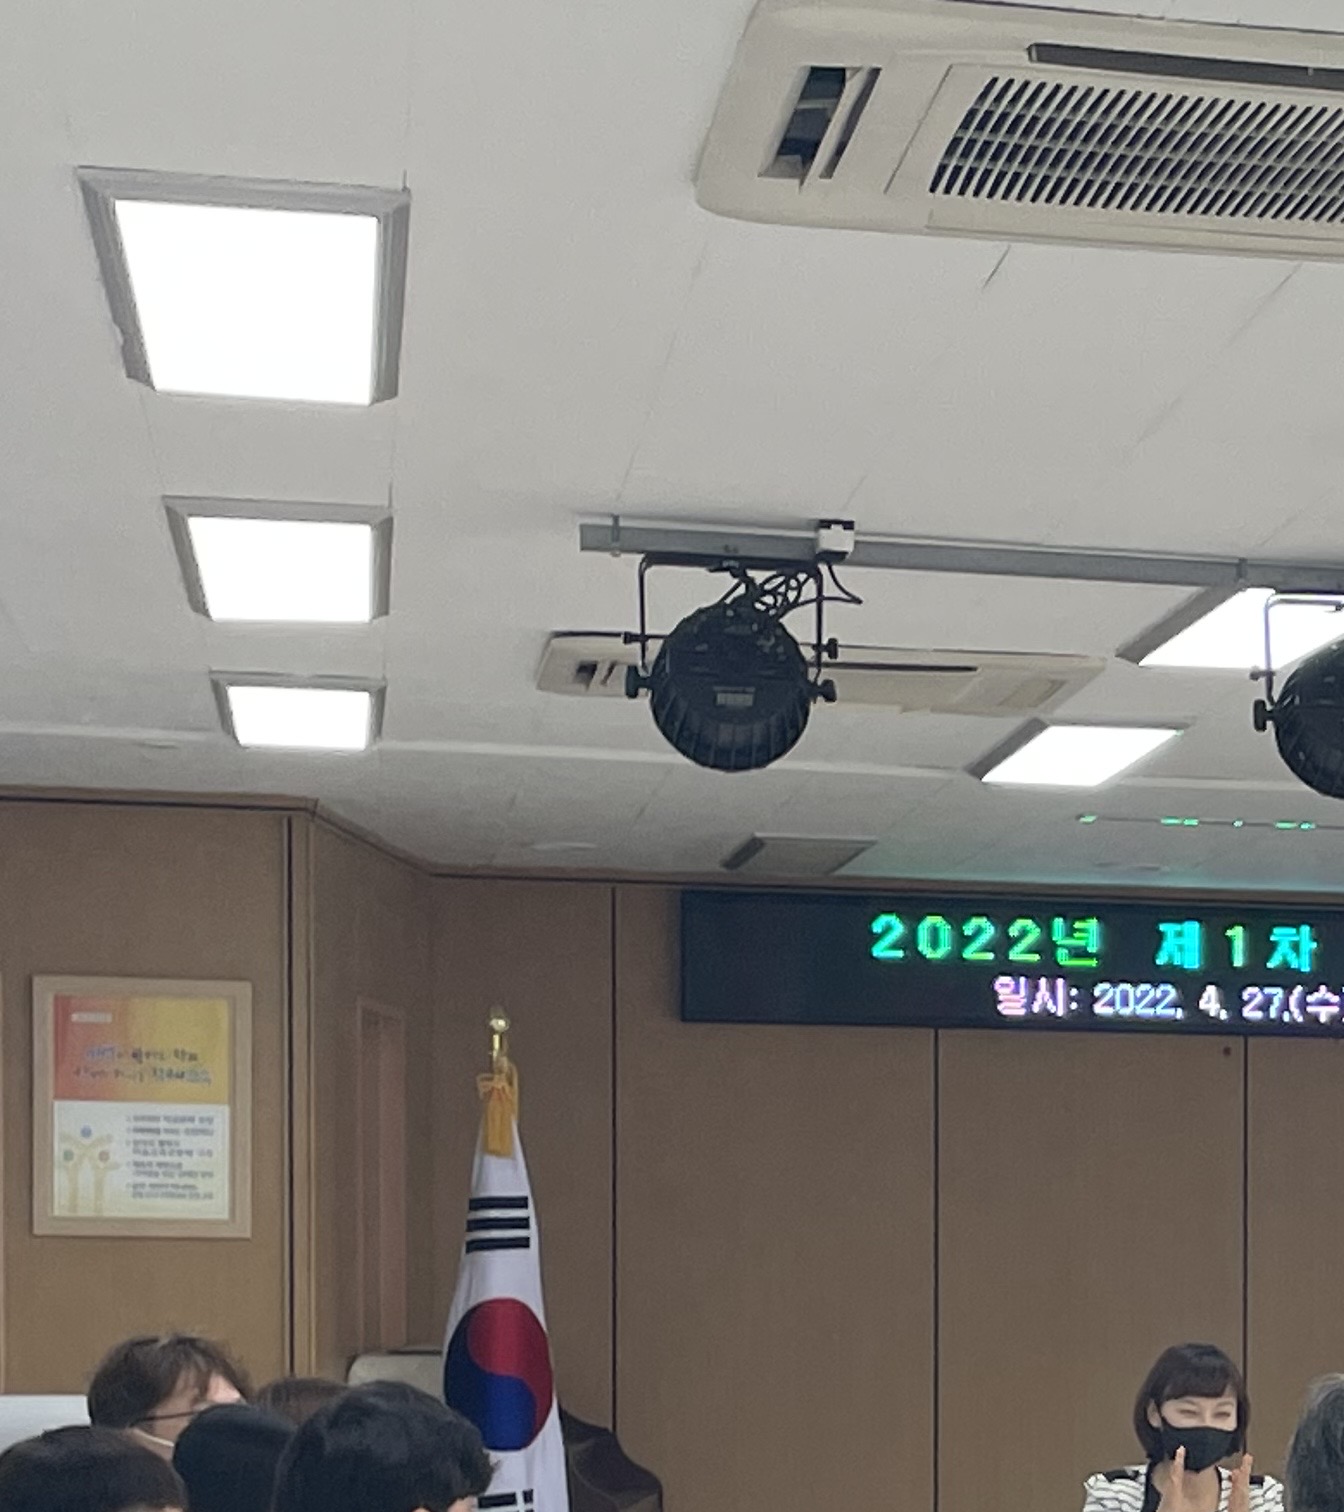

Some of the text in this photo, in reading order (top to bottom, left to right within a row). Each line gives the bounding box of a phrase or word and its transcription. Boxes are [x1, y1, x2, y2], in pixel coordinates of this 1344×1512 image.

[870, 912, 1099, 968] 2022년
[1155, 920, 1318, 973] 제1차
[993, 975, 1079, 1017] 일시:
